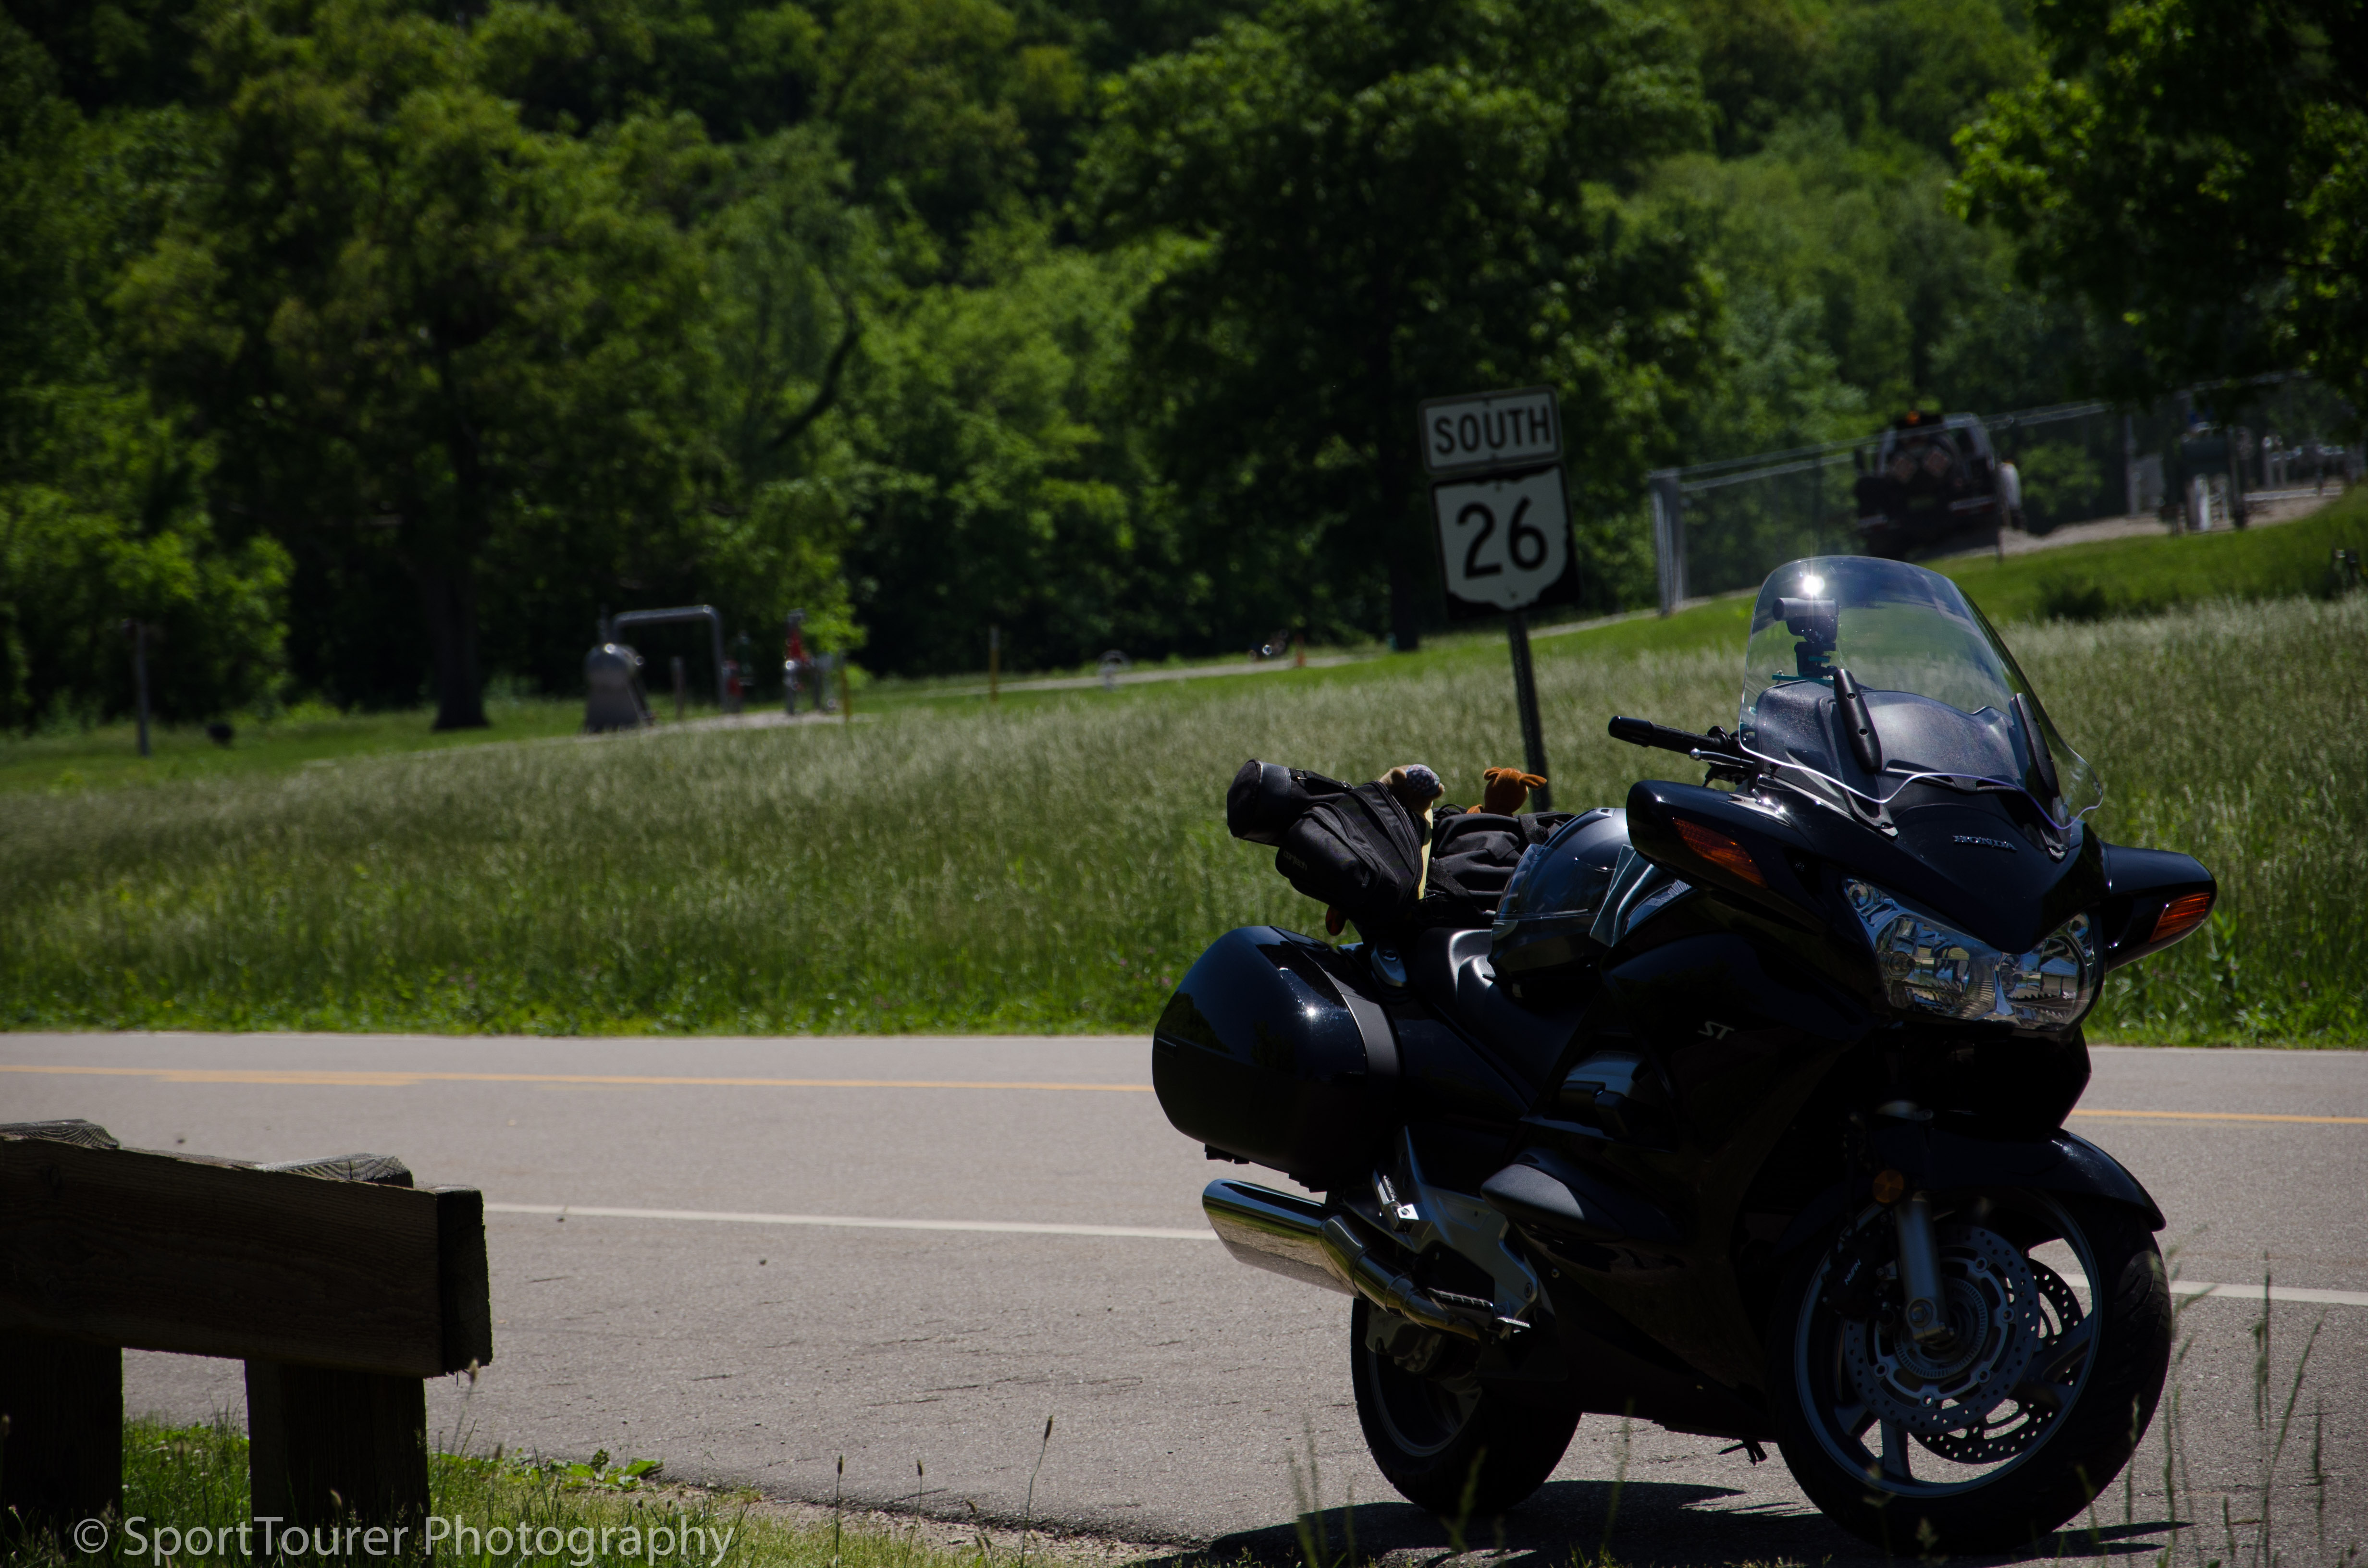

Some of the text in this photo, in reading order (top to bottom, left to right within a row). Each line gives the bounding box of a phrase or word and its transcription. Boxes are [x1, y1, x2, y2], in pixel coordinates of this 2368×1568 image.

[1435, 406, 1551, 453] SOUTH
[1458, 496, 1547, 578] 26
[1952, 835, 2018, 852] HONDA
[1697, 1020, 1736, 1040] ST
[1844, 1258, 1861, 1286] NISSIN
